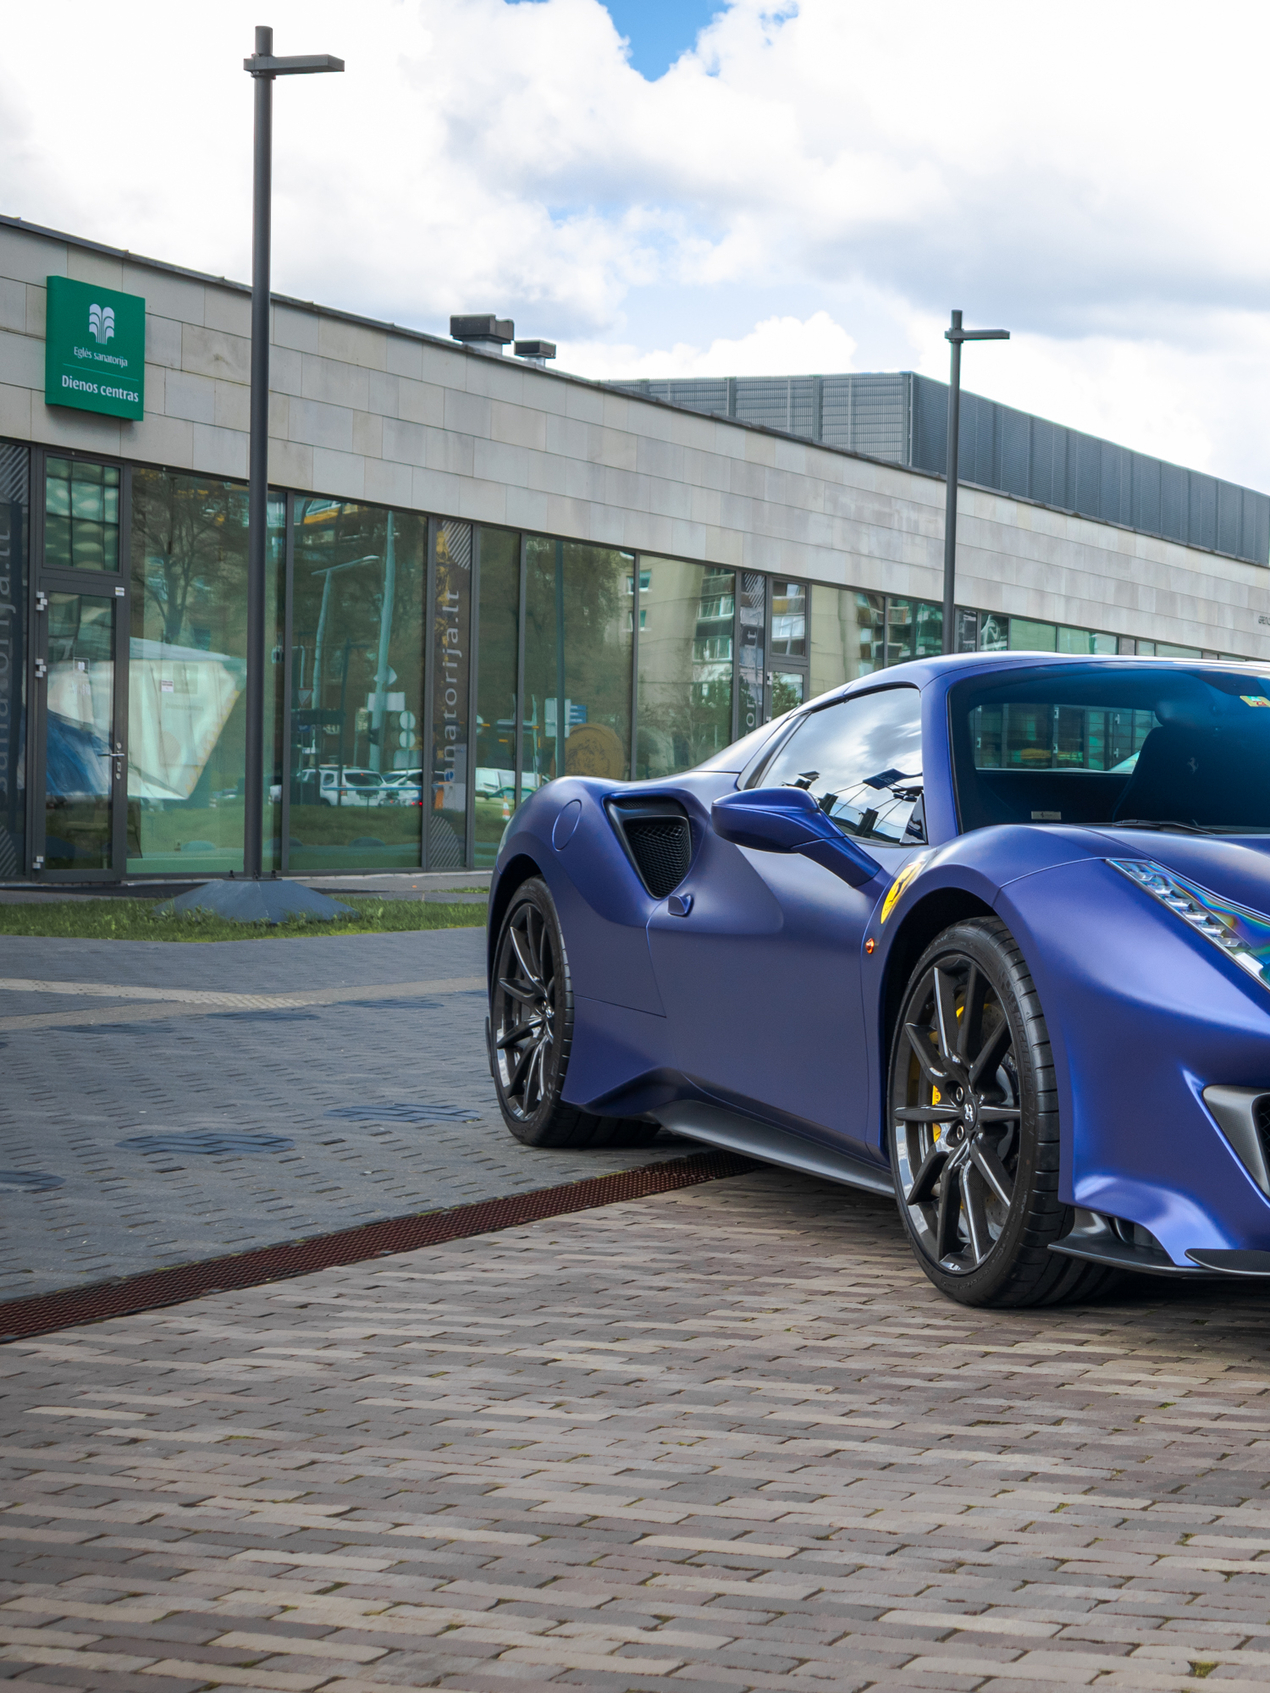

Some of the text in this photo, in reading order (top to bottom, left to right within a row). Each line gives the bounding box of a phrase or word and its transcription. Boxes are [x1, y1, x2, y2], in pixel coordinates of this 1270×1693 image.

[93, 352, 128, 368] sanatorija
[61, 374, 139, 403] Dienos centras
